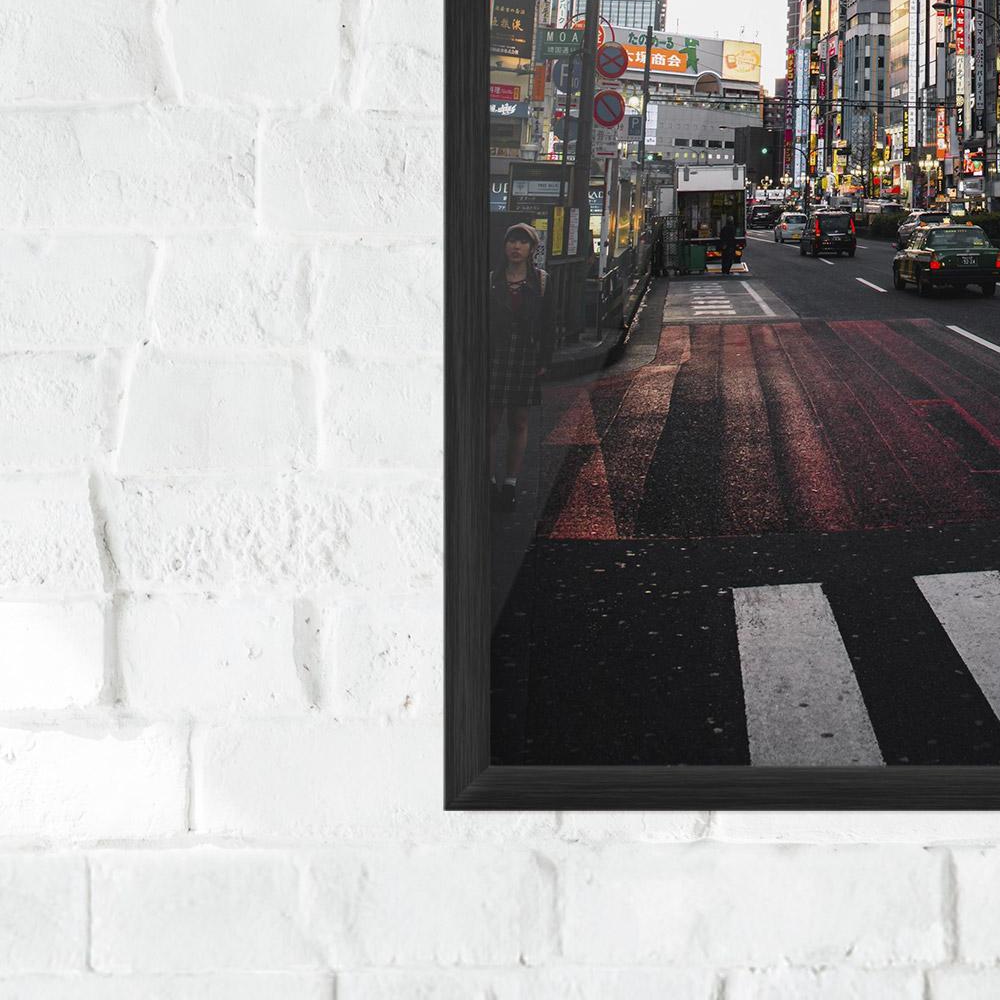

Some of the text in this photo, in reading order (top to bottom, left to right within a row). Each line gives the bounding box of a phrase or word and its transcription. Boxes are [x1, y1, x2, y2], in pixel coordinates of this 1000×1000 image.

[957, 7, 965, 35] パセラ
[546, 31, 579, 42] MOA
